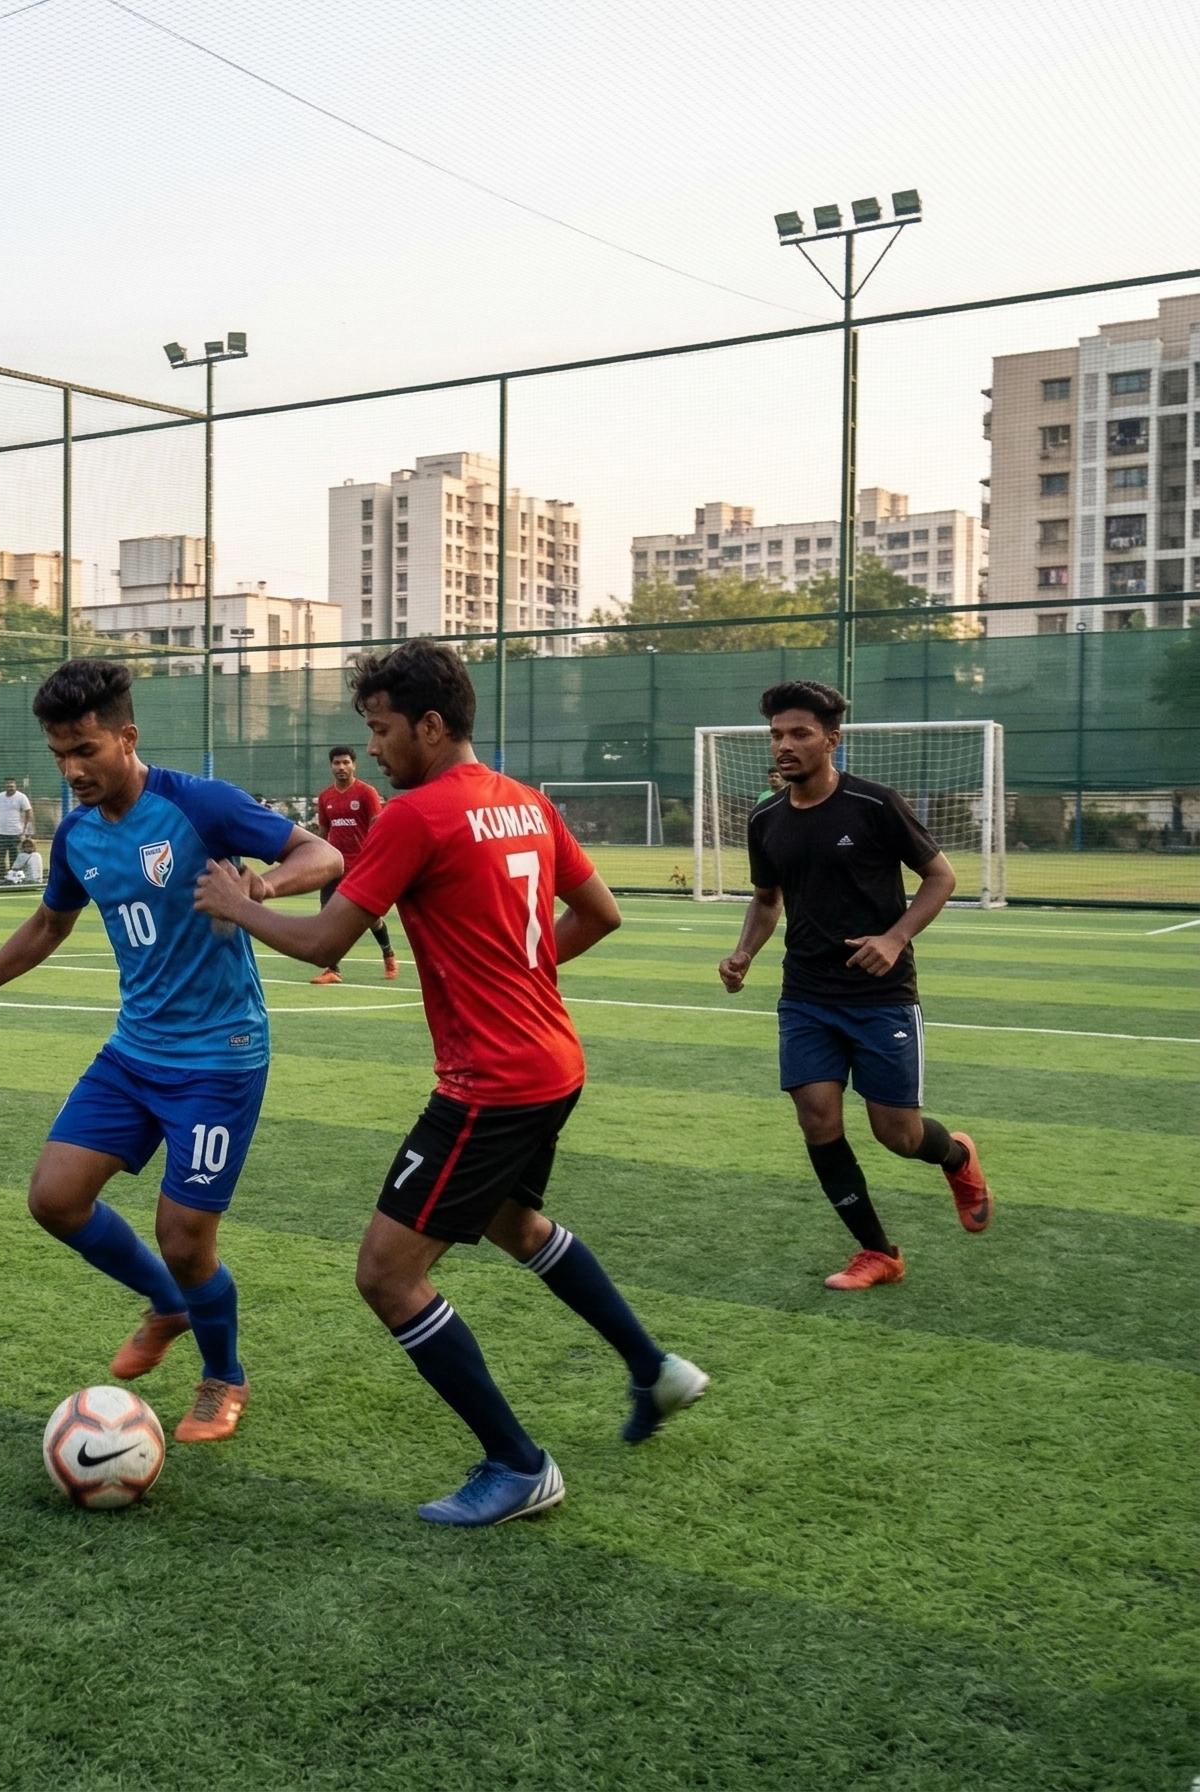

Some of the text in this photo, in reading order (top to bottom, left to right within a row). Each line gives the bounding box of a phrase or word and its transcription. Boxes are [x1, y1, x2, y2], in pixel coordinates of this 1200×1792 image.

[465, 804, 548, 843] KUMAR
[118, 901, 157, 947] 10
[505, 850, 542, 970] 7
[191, 1123, 230, 1173] 10
[393, 1149, 424, 1190] 7
